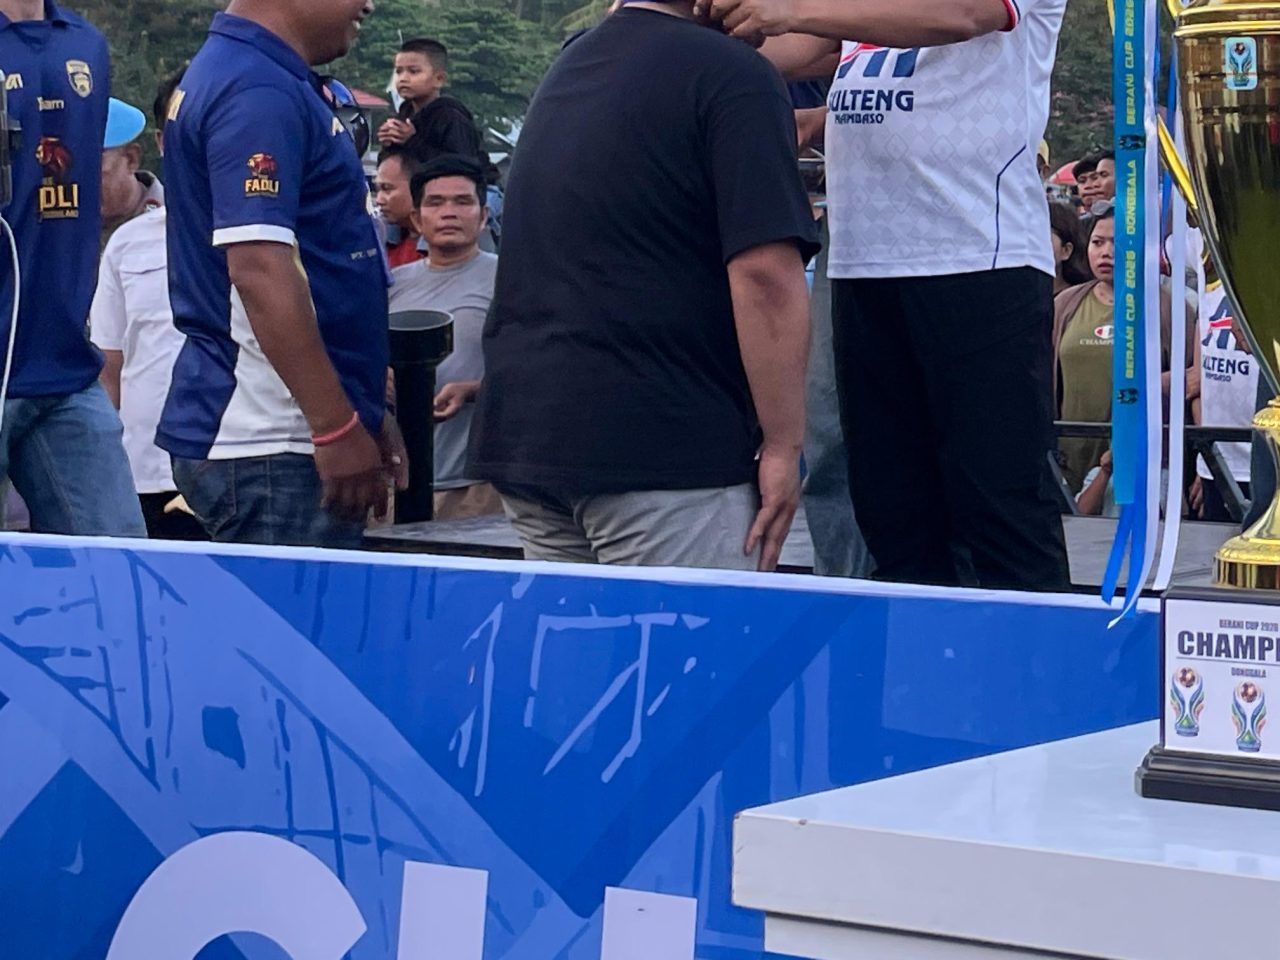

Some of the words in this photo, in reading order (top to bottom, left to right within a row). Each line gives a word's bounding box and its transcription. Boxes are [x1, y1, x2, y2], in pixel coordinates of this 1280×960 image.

[1124, 41, 1134, 69] CUP
[39, 183, 79, 210] DLI
[244, 178, 279, 193] FADLI
[1126, 293, 1135, 321] CUP
[1219, 619, 1244, 630] BERANI
[1245, 621, 1259, 630] CUP
